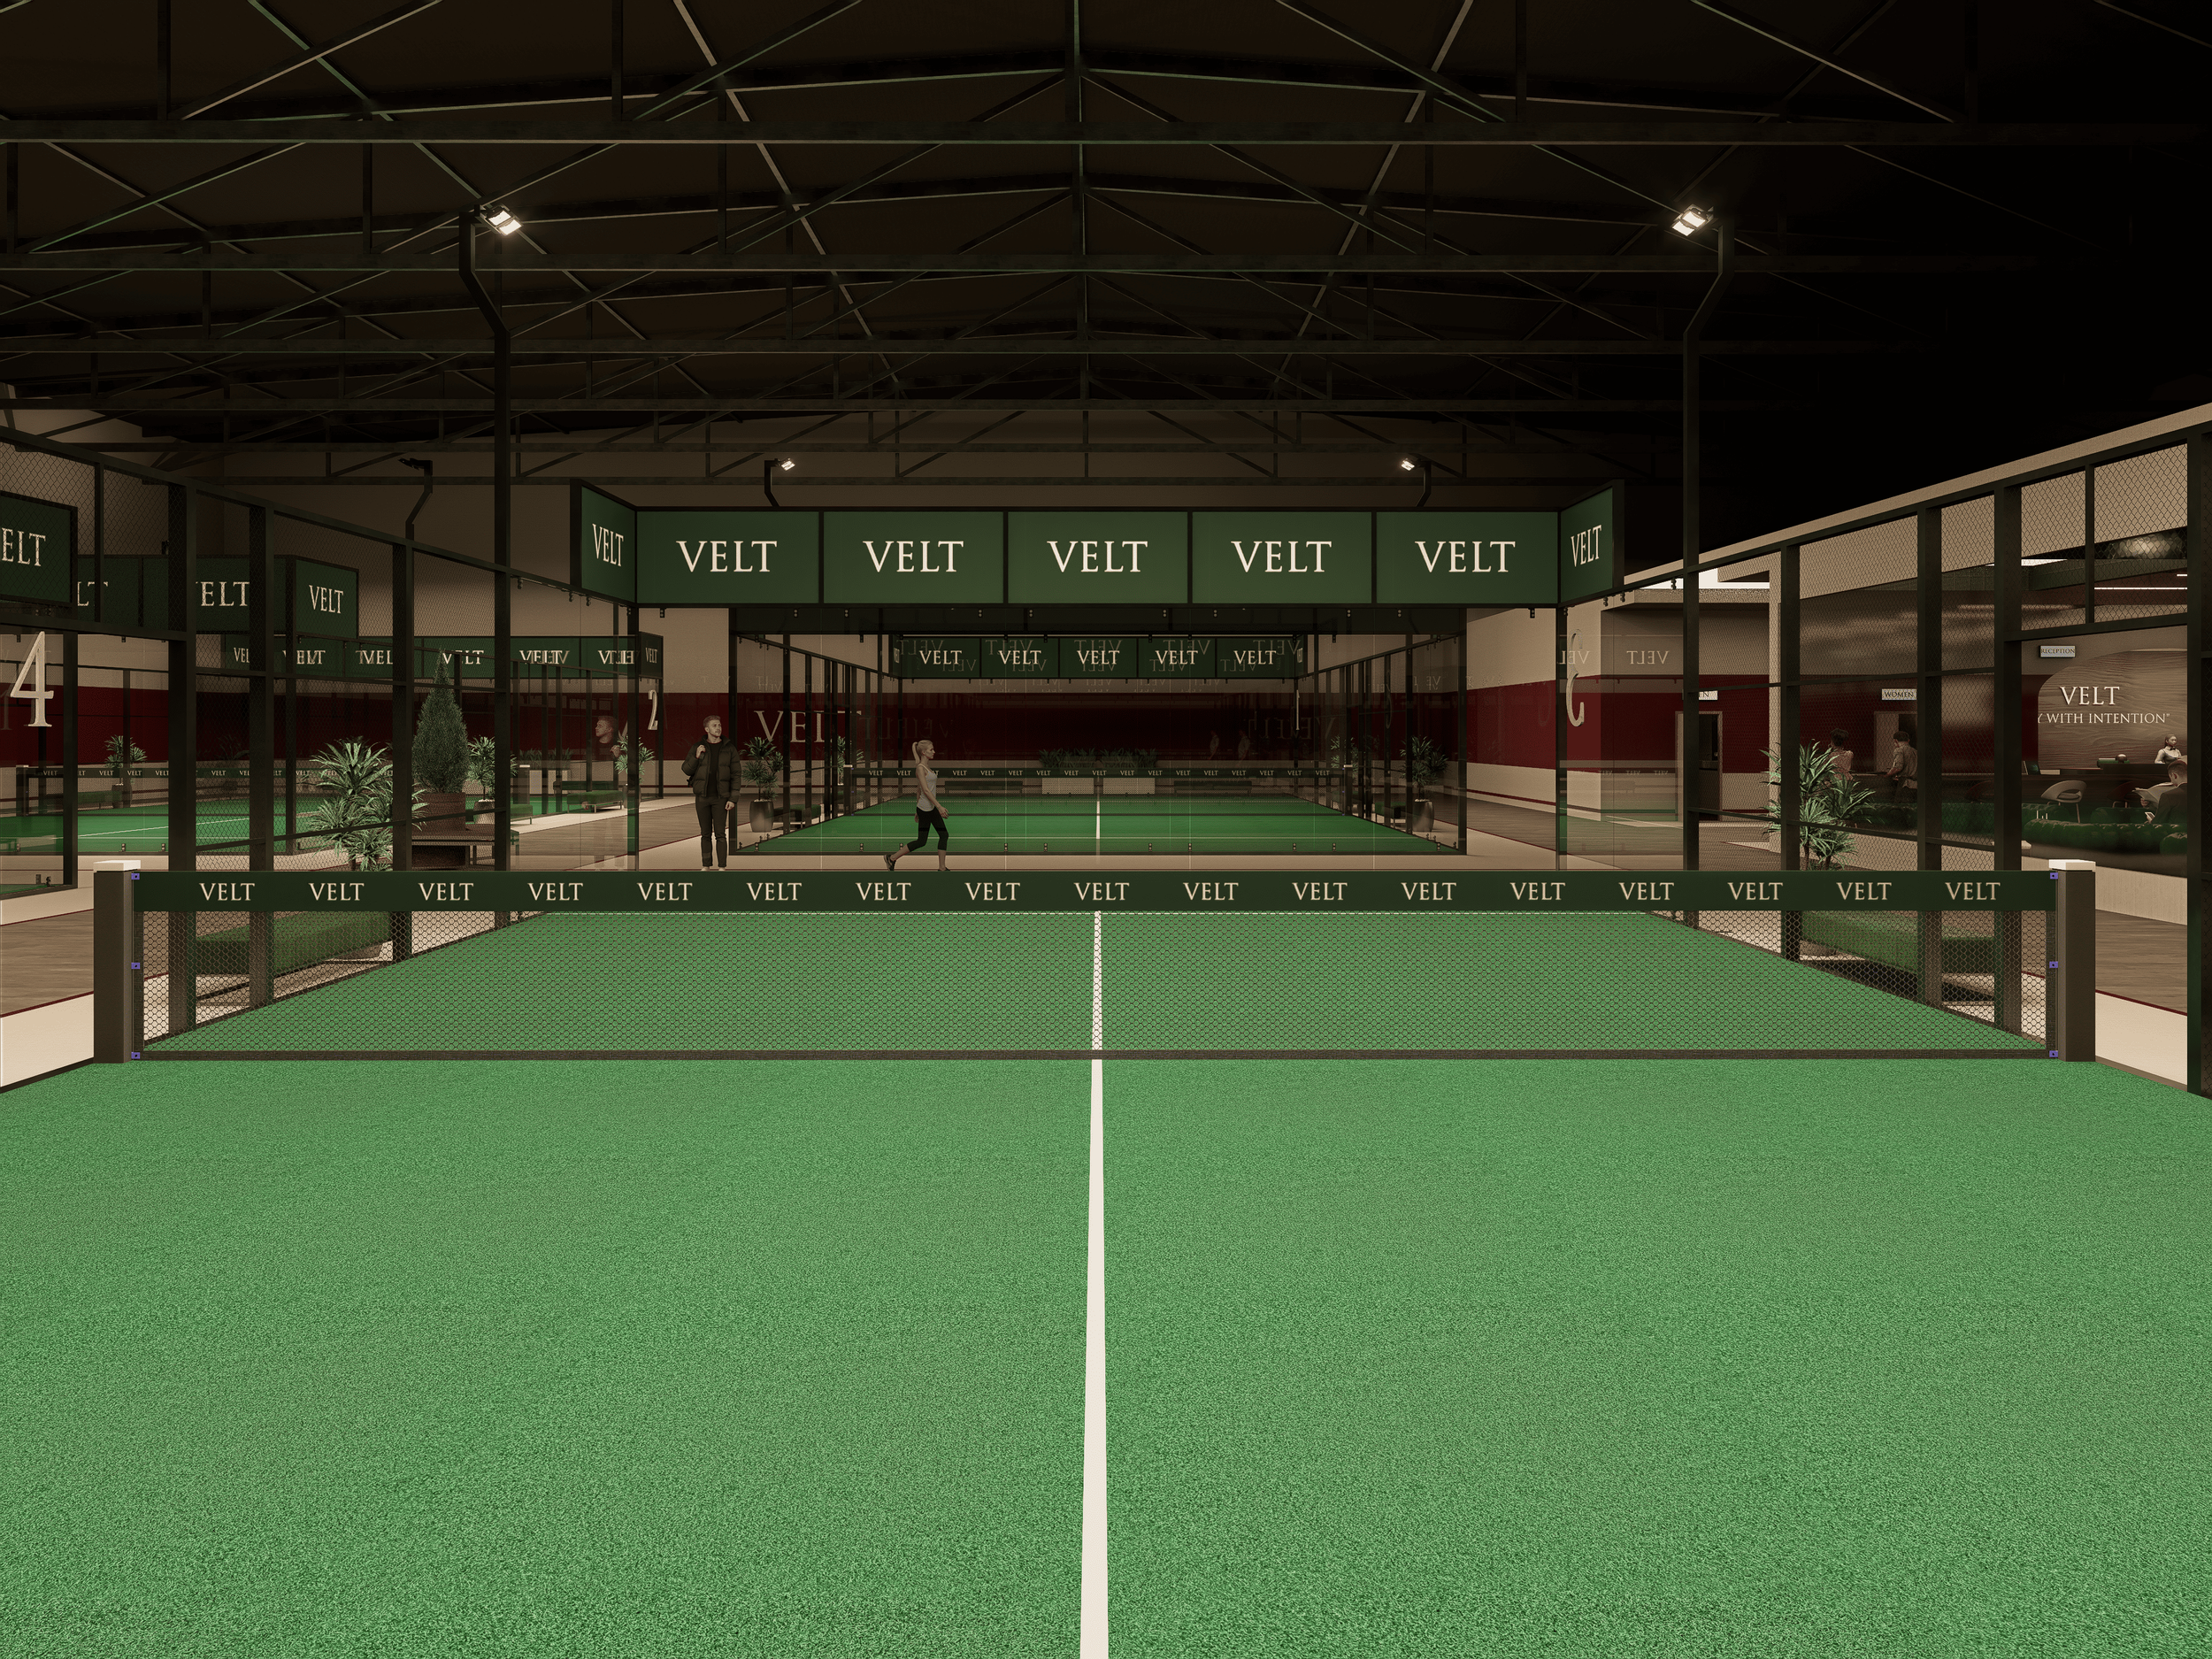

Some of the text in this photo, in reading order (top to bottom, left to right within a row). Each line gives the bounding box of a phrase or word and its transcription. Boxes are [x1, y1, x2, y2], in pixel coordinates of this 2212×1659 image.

[1, 527, 46, 566] ELT
[592, 523, 624, 567] VELT
[675, 540, 1516, 573] VELT VELT VELT VELT VELT
[1570, 525, 1602, 567] VELT
[196, 581, 250, 607] ELT
[309, 585, 344, 614] VELT
[442, 650, 484, 664] VLT
[645, 647, 658, 664] VELT
[919, 650, 1276, 664] VELT VELT VELT VELT VELT
[11, 631, 54, 727] 4
[2059, 686, 2120, 705] VELT
[648, 689, 658, 731] 2
[2047, 712, 2084, 724] WITH
[199, 882, 2001, 901] VELT VELT VELT VELT VELT VELT VELT VELT VELT VELT VELT VELT VELT VELT VELT VELT VELT
